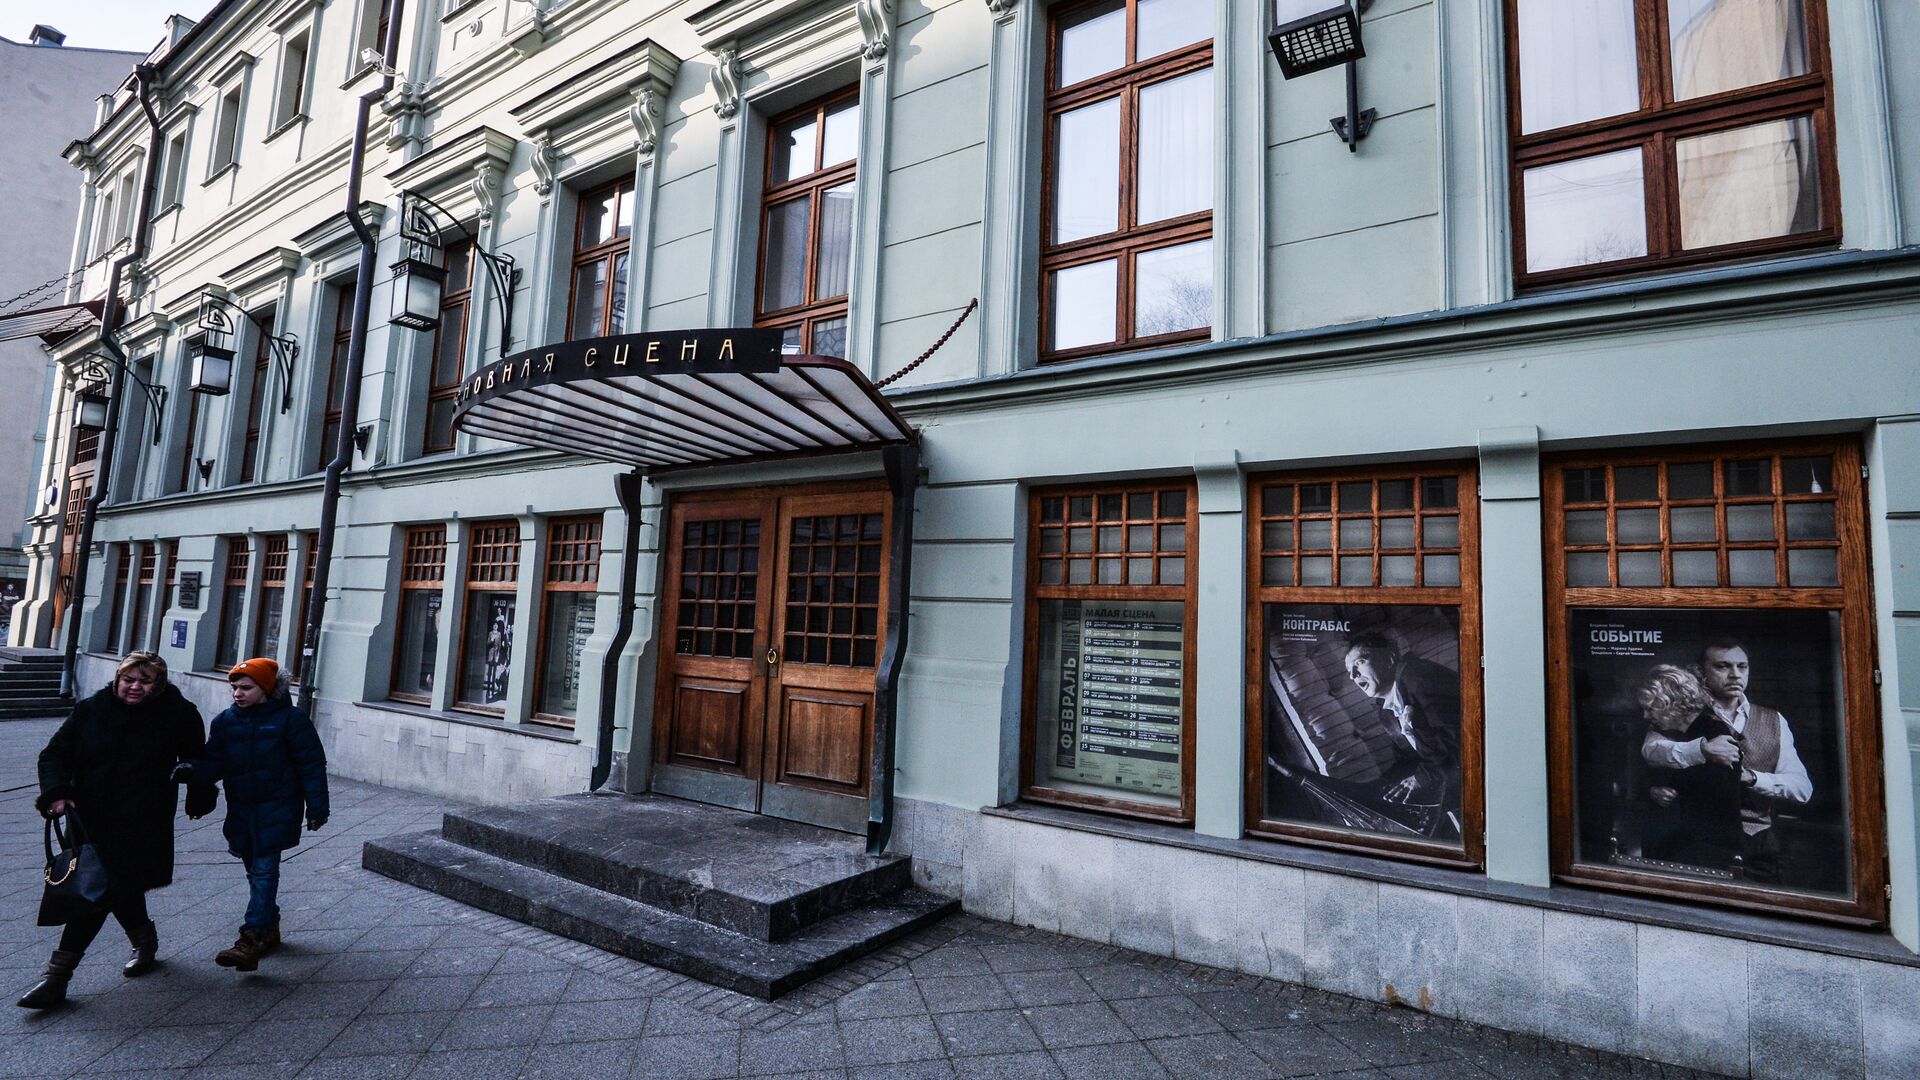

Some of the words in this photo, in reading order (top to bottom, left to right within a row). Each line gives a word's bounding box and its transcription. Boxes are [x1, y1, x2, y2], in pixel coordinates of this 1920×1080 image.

[584, 338, 734, 368] СЦЕНА
[1085, 608, 1120, 618] МАЛАЯ
[1122, 609, 1156, 619] СЦЕНА
[1282, 620, 1350, 632] КОНТРАБАС
[1590, 630, 1662, 643] СОБЫТИЕ
[564, 630, 574, 688] ФЕВРАЛЬ
[1060, 658, 1076, 749] ФЕВРАЛЬ
